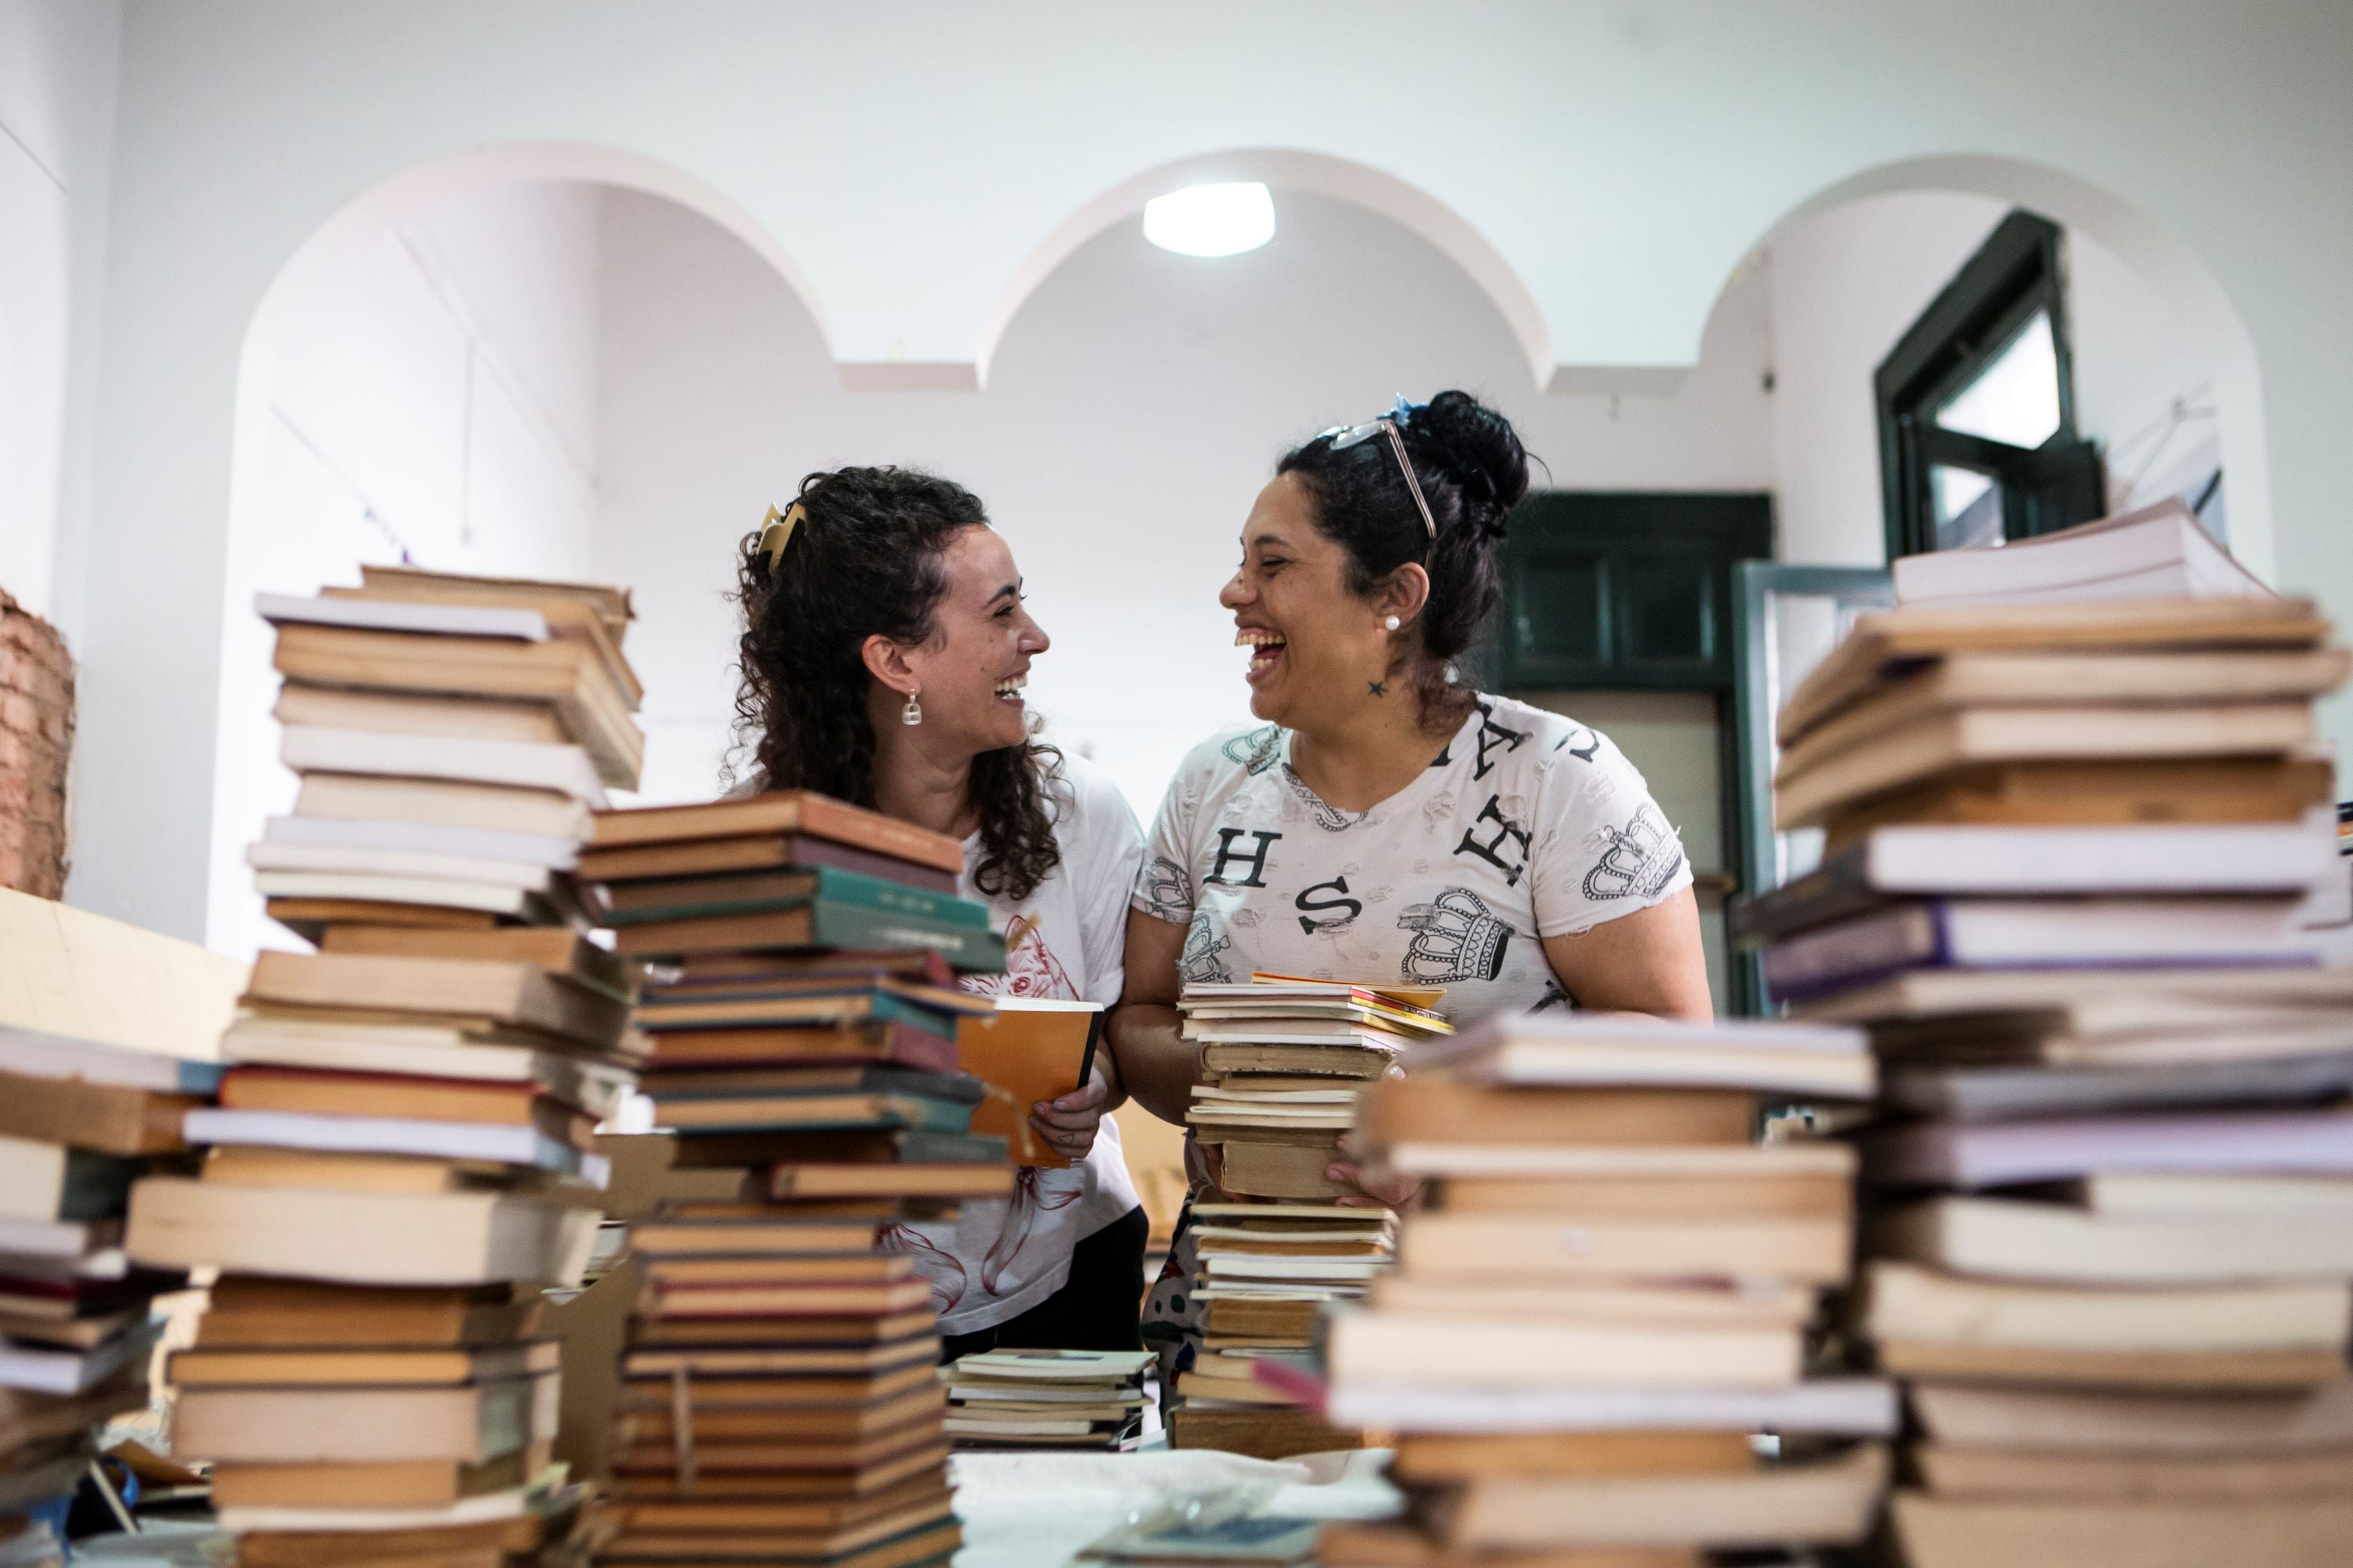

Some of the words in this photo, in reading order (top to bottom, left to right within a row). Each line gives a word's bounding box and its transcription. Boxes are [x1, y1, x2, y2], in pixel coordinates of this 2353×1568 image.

[1472, 700, 1535, 781] A
[1203, 827, 1283, 888] H
[1453, 793, 1532, 888] H
[1295, 875, 1362, 935] S
